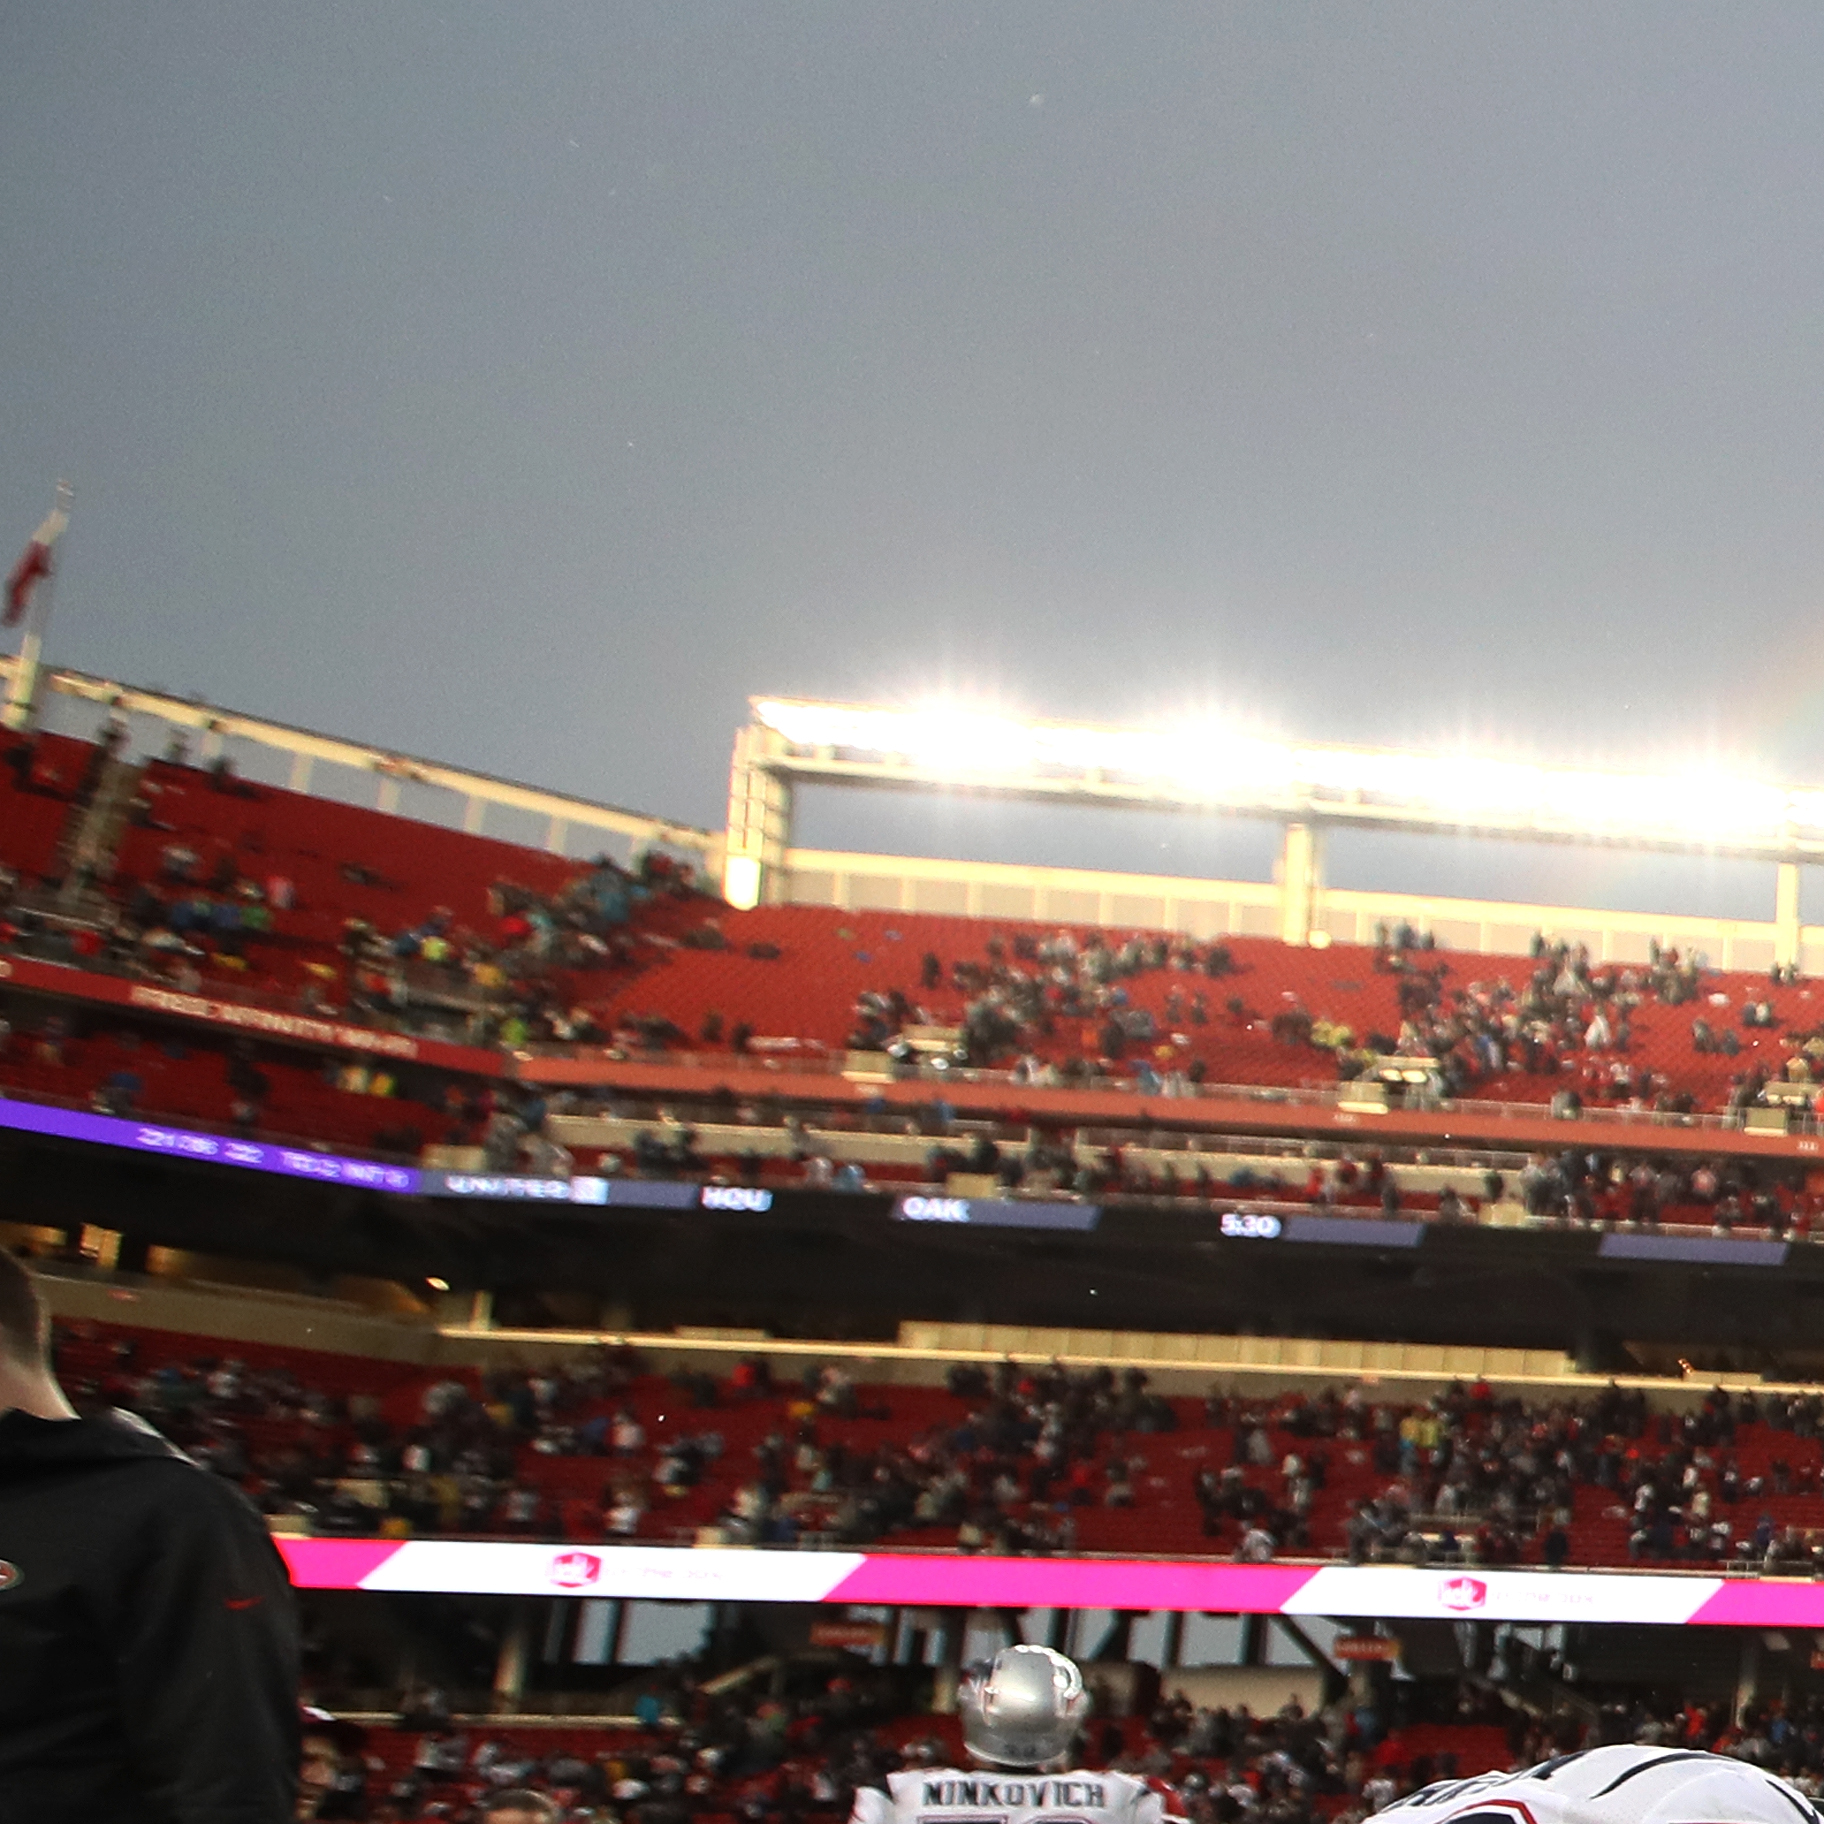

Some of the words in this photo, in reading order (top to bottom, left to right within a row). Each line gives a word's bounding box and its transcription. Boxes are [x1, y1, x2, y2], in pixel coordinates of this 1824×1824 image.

[902, 1196, 970, 1223] OAK
[1220, 1212, 1282, 1240] 5:30
[921, 1781, 1105, 1808] NINKOVICH
